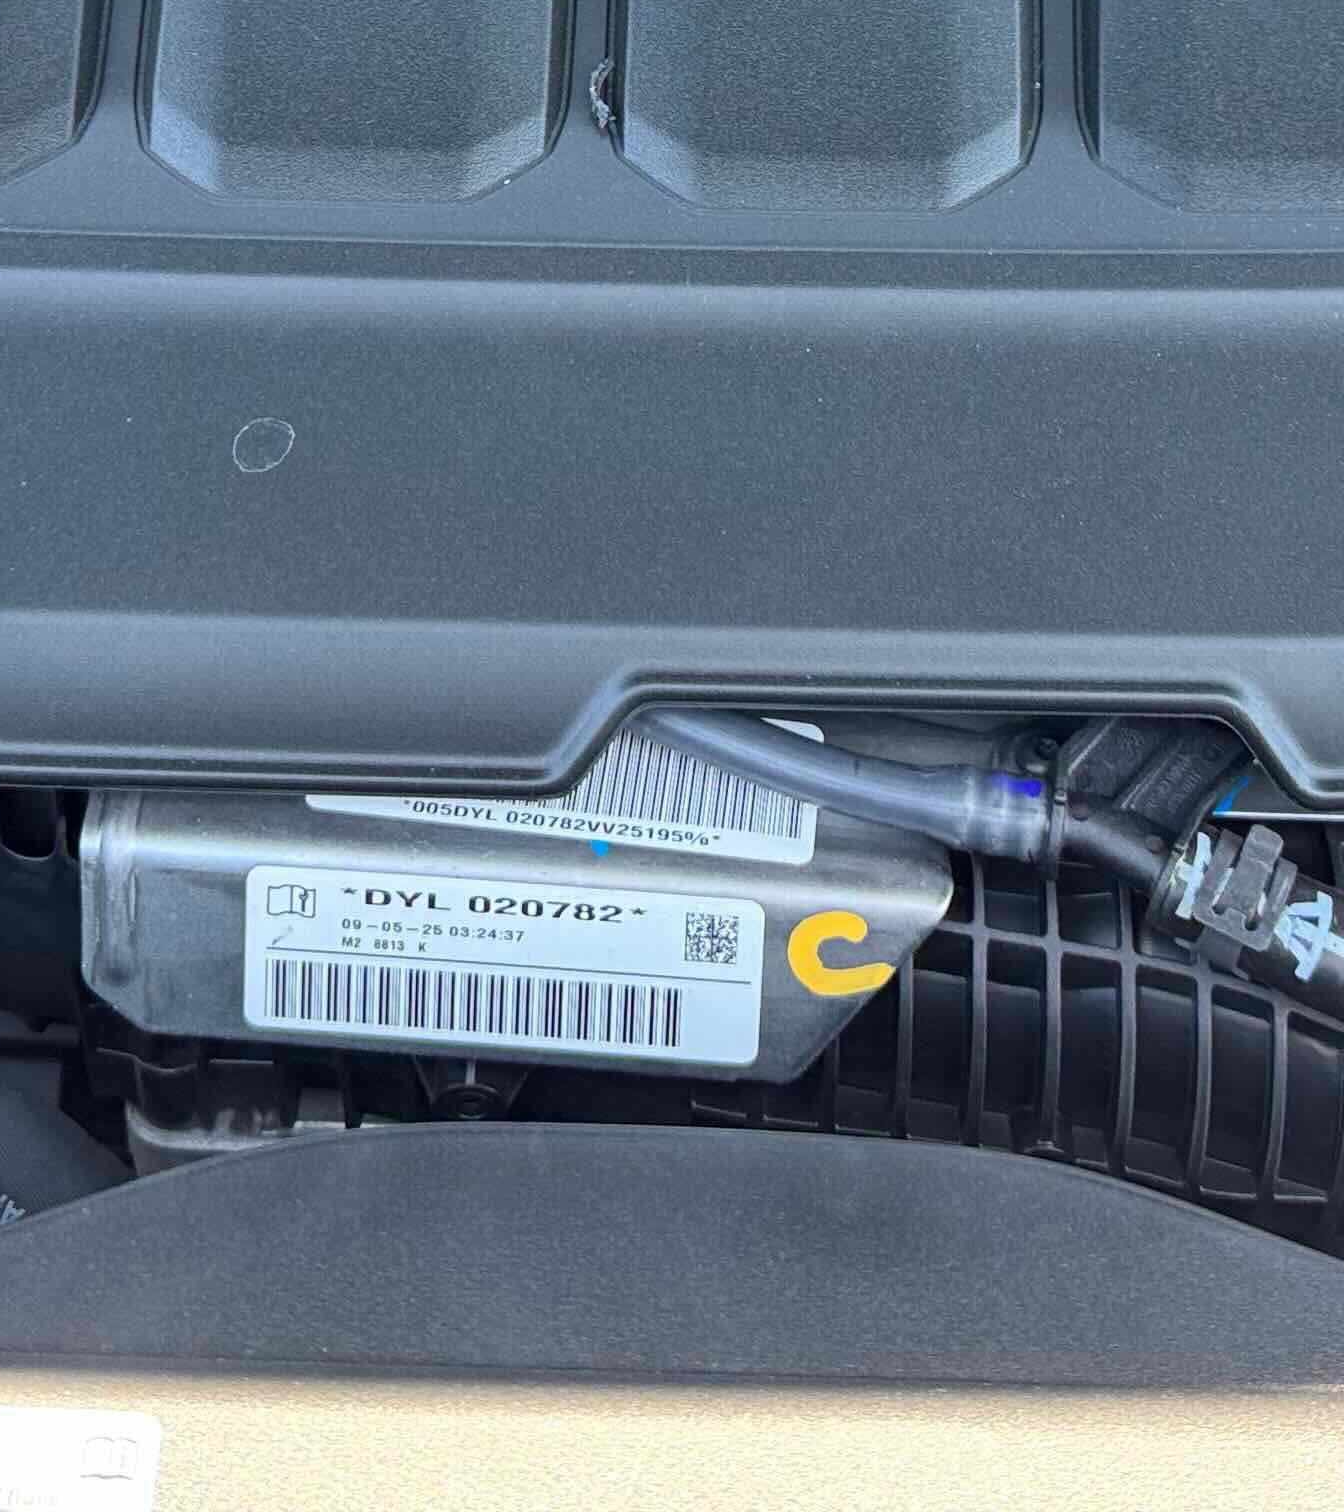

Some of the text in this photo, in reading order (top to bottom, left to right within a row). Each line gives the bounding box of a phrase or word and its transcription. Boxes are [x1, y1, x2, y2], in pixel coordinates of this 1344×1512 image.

[449, 925, 525, 943] 03:24:37
[341, 936, 361, 949] M2
[418, 941, 426, 952] K
